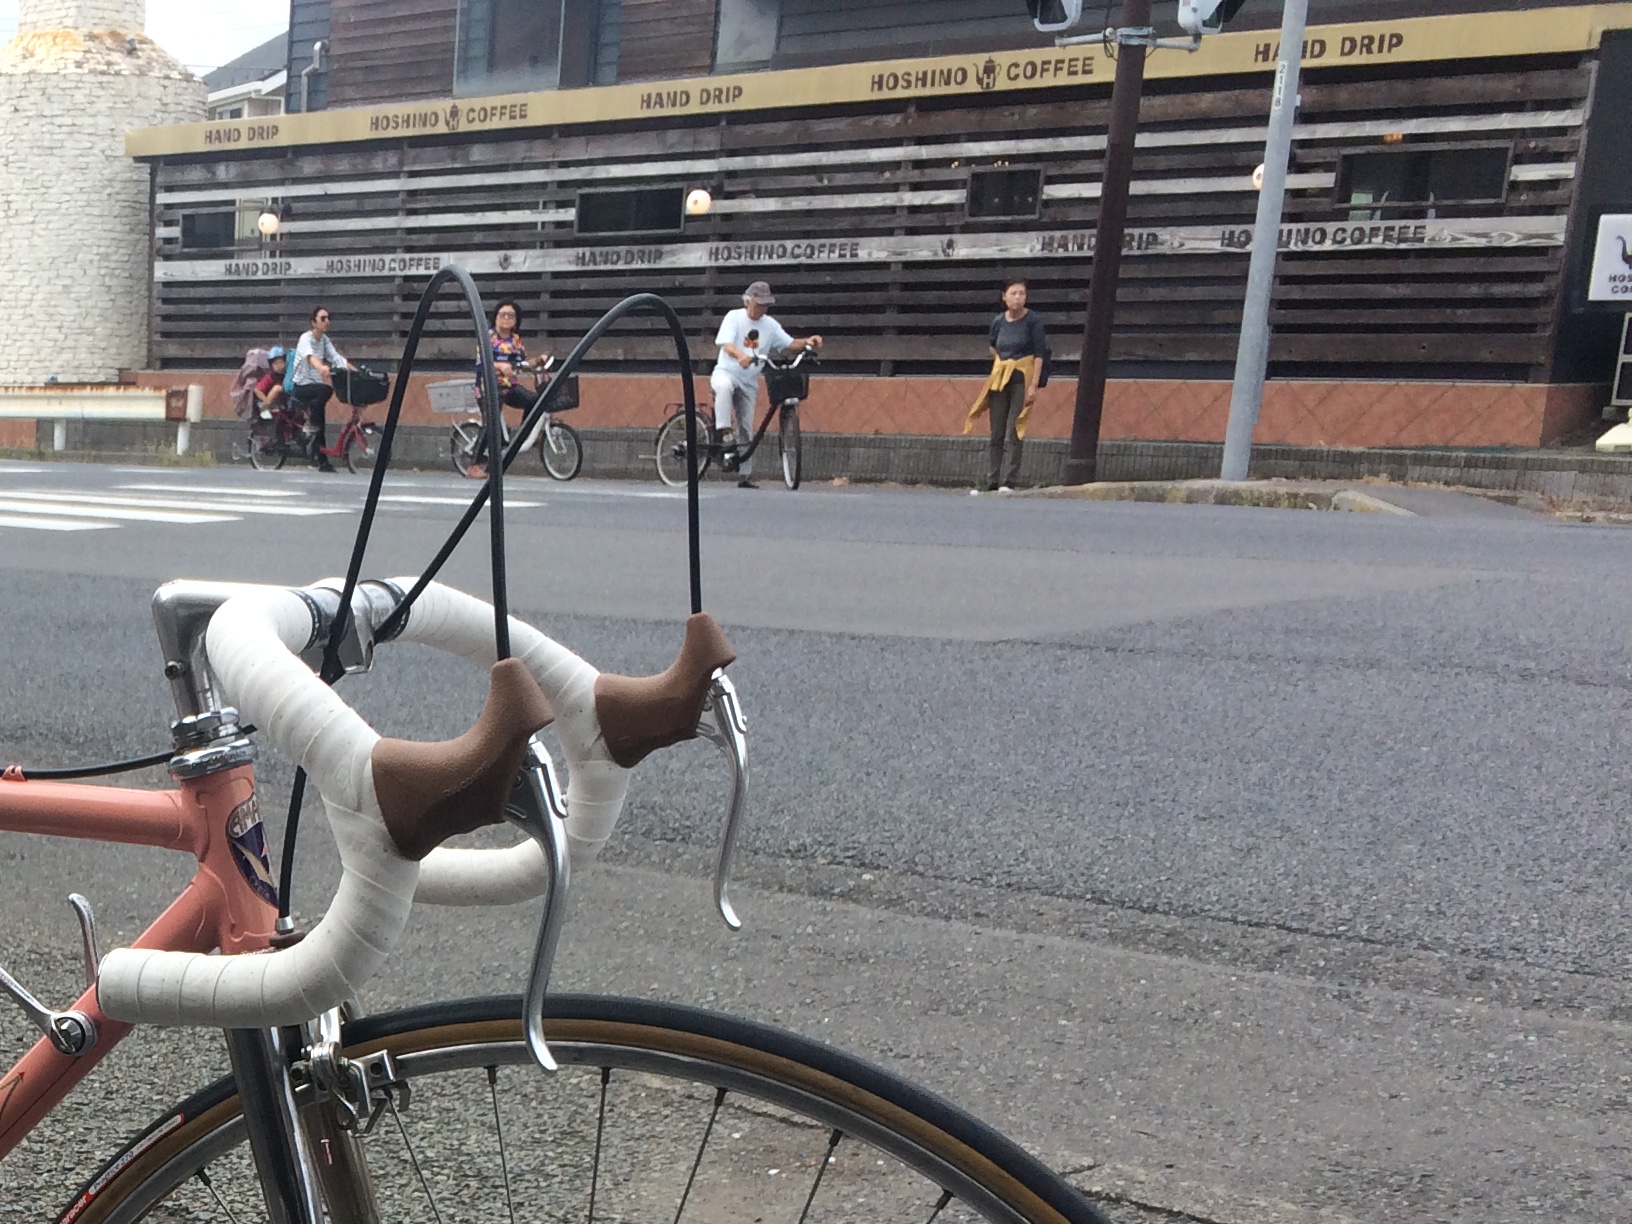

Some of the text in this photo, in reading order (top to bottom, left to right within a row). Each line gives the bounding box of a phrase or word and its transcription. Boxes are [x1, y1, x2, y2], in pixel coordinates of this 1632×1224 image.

[1340, 33, 1403, 57] DRIP
[870, 56, 1094, 92] HOSHINO COFFEE
[1275, 64, 1286, 107] 2118
[640, 85, 743, 110] HAND DRIP
[370, 103, 528, 132] HOSHINO COFFEE
[204, 125, 280, 144] HAND DRIP
[1332, 225, 1427, 246] COFFEE
[575, 249, 664, 267] HAND DRIP
[709, 242, 860, 262] HOSHINO COFFEE
[224, 261, 292, 276] HAND DRIP
[326, 257, 441, 273] HOSHINO COFFEE
